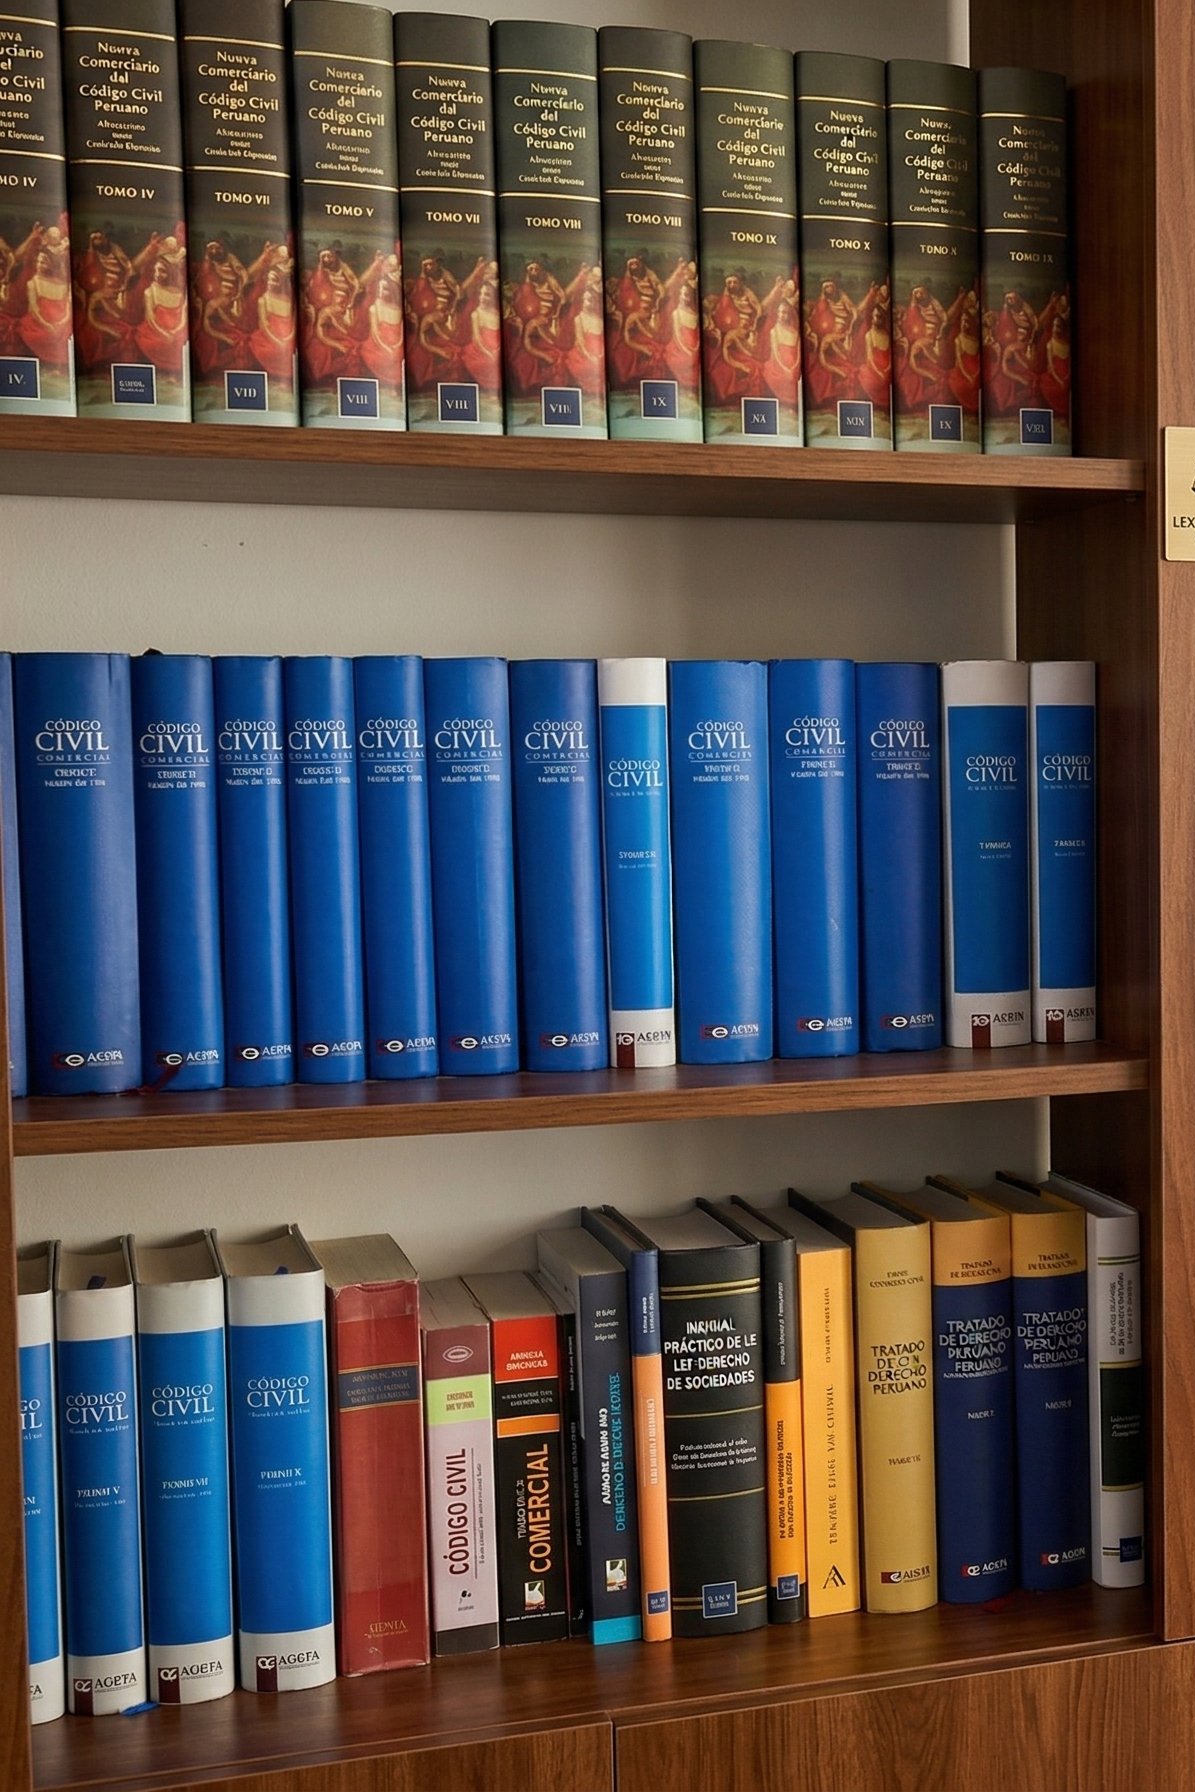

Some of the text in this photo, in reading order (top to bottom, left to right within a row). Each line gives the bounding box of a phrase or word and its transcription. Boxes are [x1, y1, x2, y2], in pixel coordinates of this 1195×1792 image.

[0, 58, 11, 71] el
[79, 56, 160, 74] Comerciario
[13, 75, 45, 90] Civil
[0, 91, 32, 104] uano
[79, 84, 162, 102] Código Civil
[94, 100, 148, 115] Peruano
[199, 93, 279, 111] Código Civil
[337, 96, 355, 108] del
[213, 109, 266, 123] Peruano
[308, 108, 385, 126] Código Civil
[322, 123, 372, 138] Peruano
[411, 116, 485, 132] Código Civil
[513, 123, 586, 139] Código Civil
[616, 121, 657, 136] Código
[424, 131, 473, 144] Peruano
[526, 137, 574, 151] Peruano
[629, 135, 675, 148] Peruano
[717, 140, 757, 155] Código
[729, 154, 775, 168] Peruano
[814, 148, 853, 163] Código
[826, 162, 869, 176] Peruano
[23, 177, 37, 187] IV
[97, 185, 154, 199] TOMO IV
[215, 192, 251, 203] TOMO
[366, 208, 374, 217] V
[426, 212, 480, 224] TOMO VII
[626, 213, 682, 227] TOMO VIII
[526, 217, 560, 229] TOMO
[766, 234, 777, 245] IX
[864, 241, 871, 250] X
[1173, 516, 1195, 528] LEX
[45, 718, 101, 731] CÓDIGO
[148, 721, 200, 734] CÓDIGO
[224, 719, 276, 732] CÓDIGO
[294, 718, 345, 730] CÓDIGO
[367, 717, 417, 730] CÓDIGO
[443, 718, 493, 730] CÓDIGO
[533, 720, 582, 731] CÓDIGO
[697, 719, 743, 731] CÓDIGO
[794, 715, 838, 728] CÓDIGO
[35, 732, 109, 751] CIVIL
[140, 734, 208, 753] CIVIL
[218, 732, 282, 750] CIVIL
[288, 731, 352, 750] CIVIL
[359, 730, 423, 748] CIVIL
[434, 730, 501, 749] CIVIL
[524, 732, 588, 750] CIVIL
[688, 732, 751, 749] CIVIL
[785, 728, 846, 746] CIVIL
[870, 731, 930, 748] CIVIL
[609, 758, 660, 771] CÓDIGO
[966, 755, 1016, 767] CÓDIGO
[608, 771, 663, 787] CIVIL
[966, 767, 1017, 782] CIVIL
[1042, 766, 1092, 781] CIVIL
[947, 1315, 1004, 1333] TRATADO
[1018, 1326, 1034, 1337] DE
[664, 1333, 757, 1354] PRÁCTICO DE LE
[939, 1334, 957, 1346] DE
[871, 1340, 925, 1357] TRATADO
[247, 1375, 309, 1390] CÓDIGO
[667, 1370, 754, 1390] DE SOCIEDADES
[873, 1378, 926, 1394] PERUANO
[152, 1383, 213, 1399] CÓDIGO
[247, 1388, 310, 1408] CIVIL
[66, 1391, 127, 1407] CÓDIGO
[66, 1404, 128, 1424] CIVIL
[152, 1397, 214, 1417] CIVIL
[443, 1448, 470, 1575] CÓDIGO CIVIL
[526, 1444, 551, 1574] COMERCIAL
